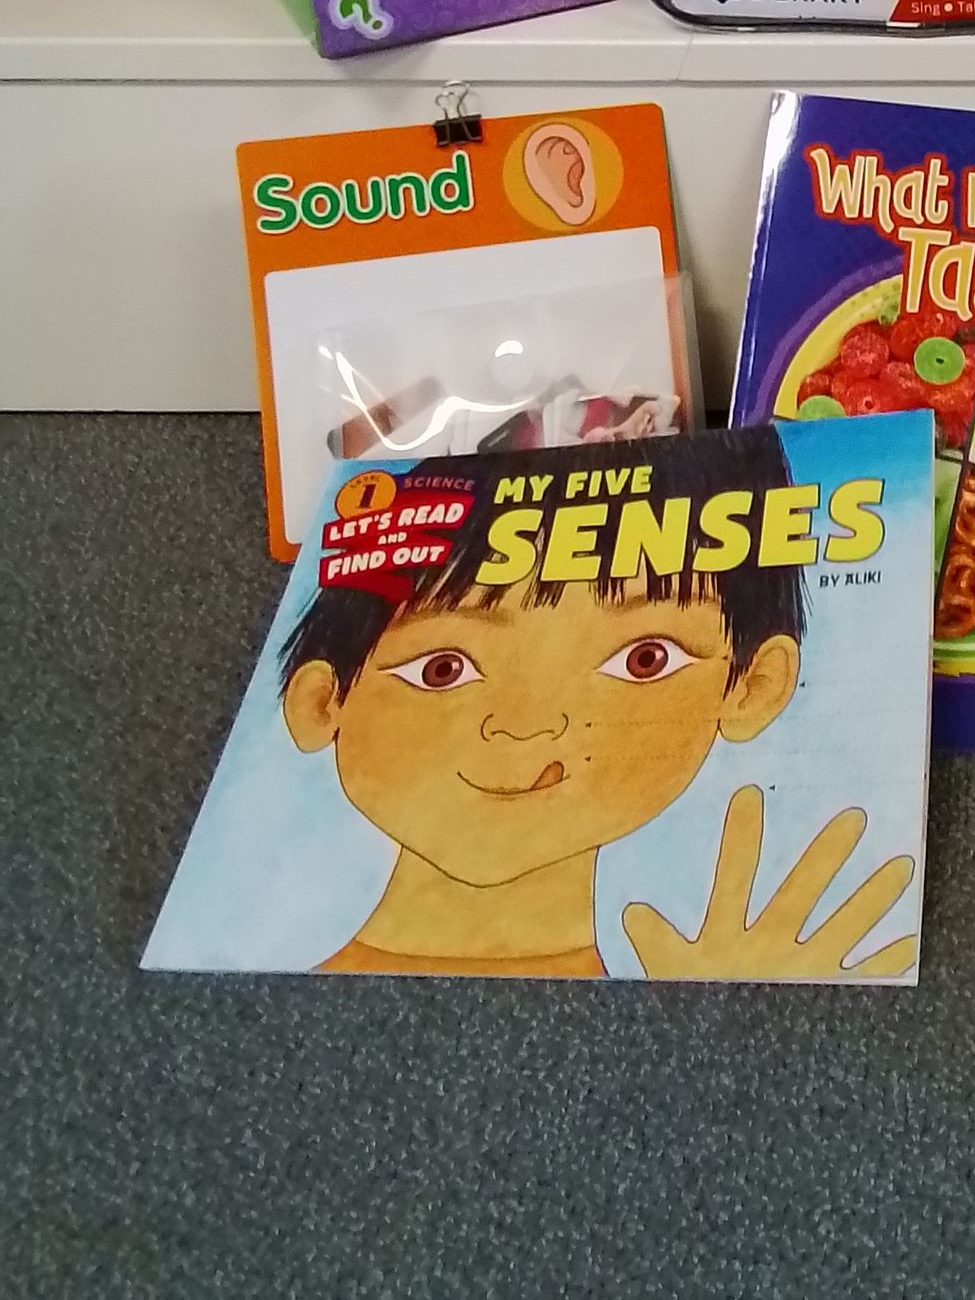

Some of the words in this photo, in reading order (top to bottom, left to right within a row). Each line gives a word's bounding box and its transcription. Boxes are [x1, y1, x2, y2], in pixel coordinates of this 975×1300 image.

[911, 2, 940, 15] Sing
[255, 150, 474, 234] Sound
[810, 149, 949, 233] What
[357, 484, 376, 509] 1
[404, 476, 475, 491] SCIENCE
[494, 476, 553, 505] MY
[565, 466, 652, 501] FIVE
[329, 511, 392, 541] LET'S
[398, 503, 464, 527] READ
[378, 532, 407, 545] AND
[475, 479, 885, 586] SENSES
[327, 551, 386, 580] FIND
[392, 546, 445, 565] OUT
[819, 574, 840, 588] BY
[845, 569, 882, 586] ALIKI
